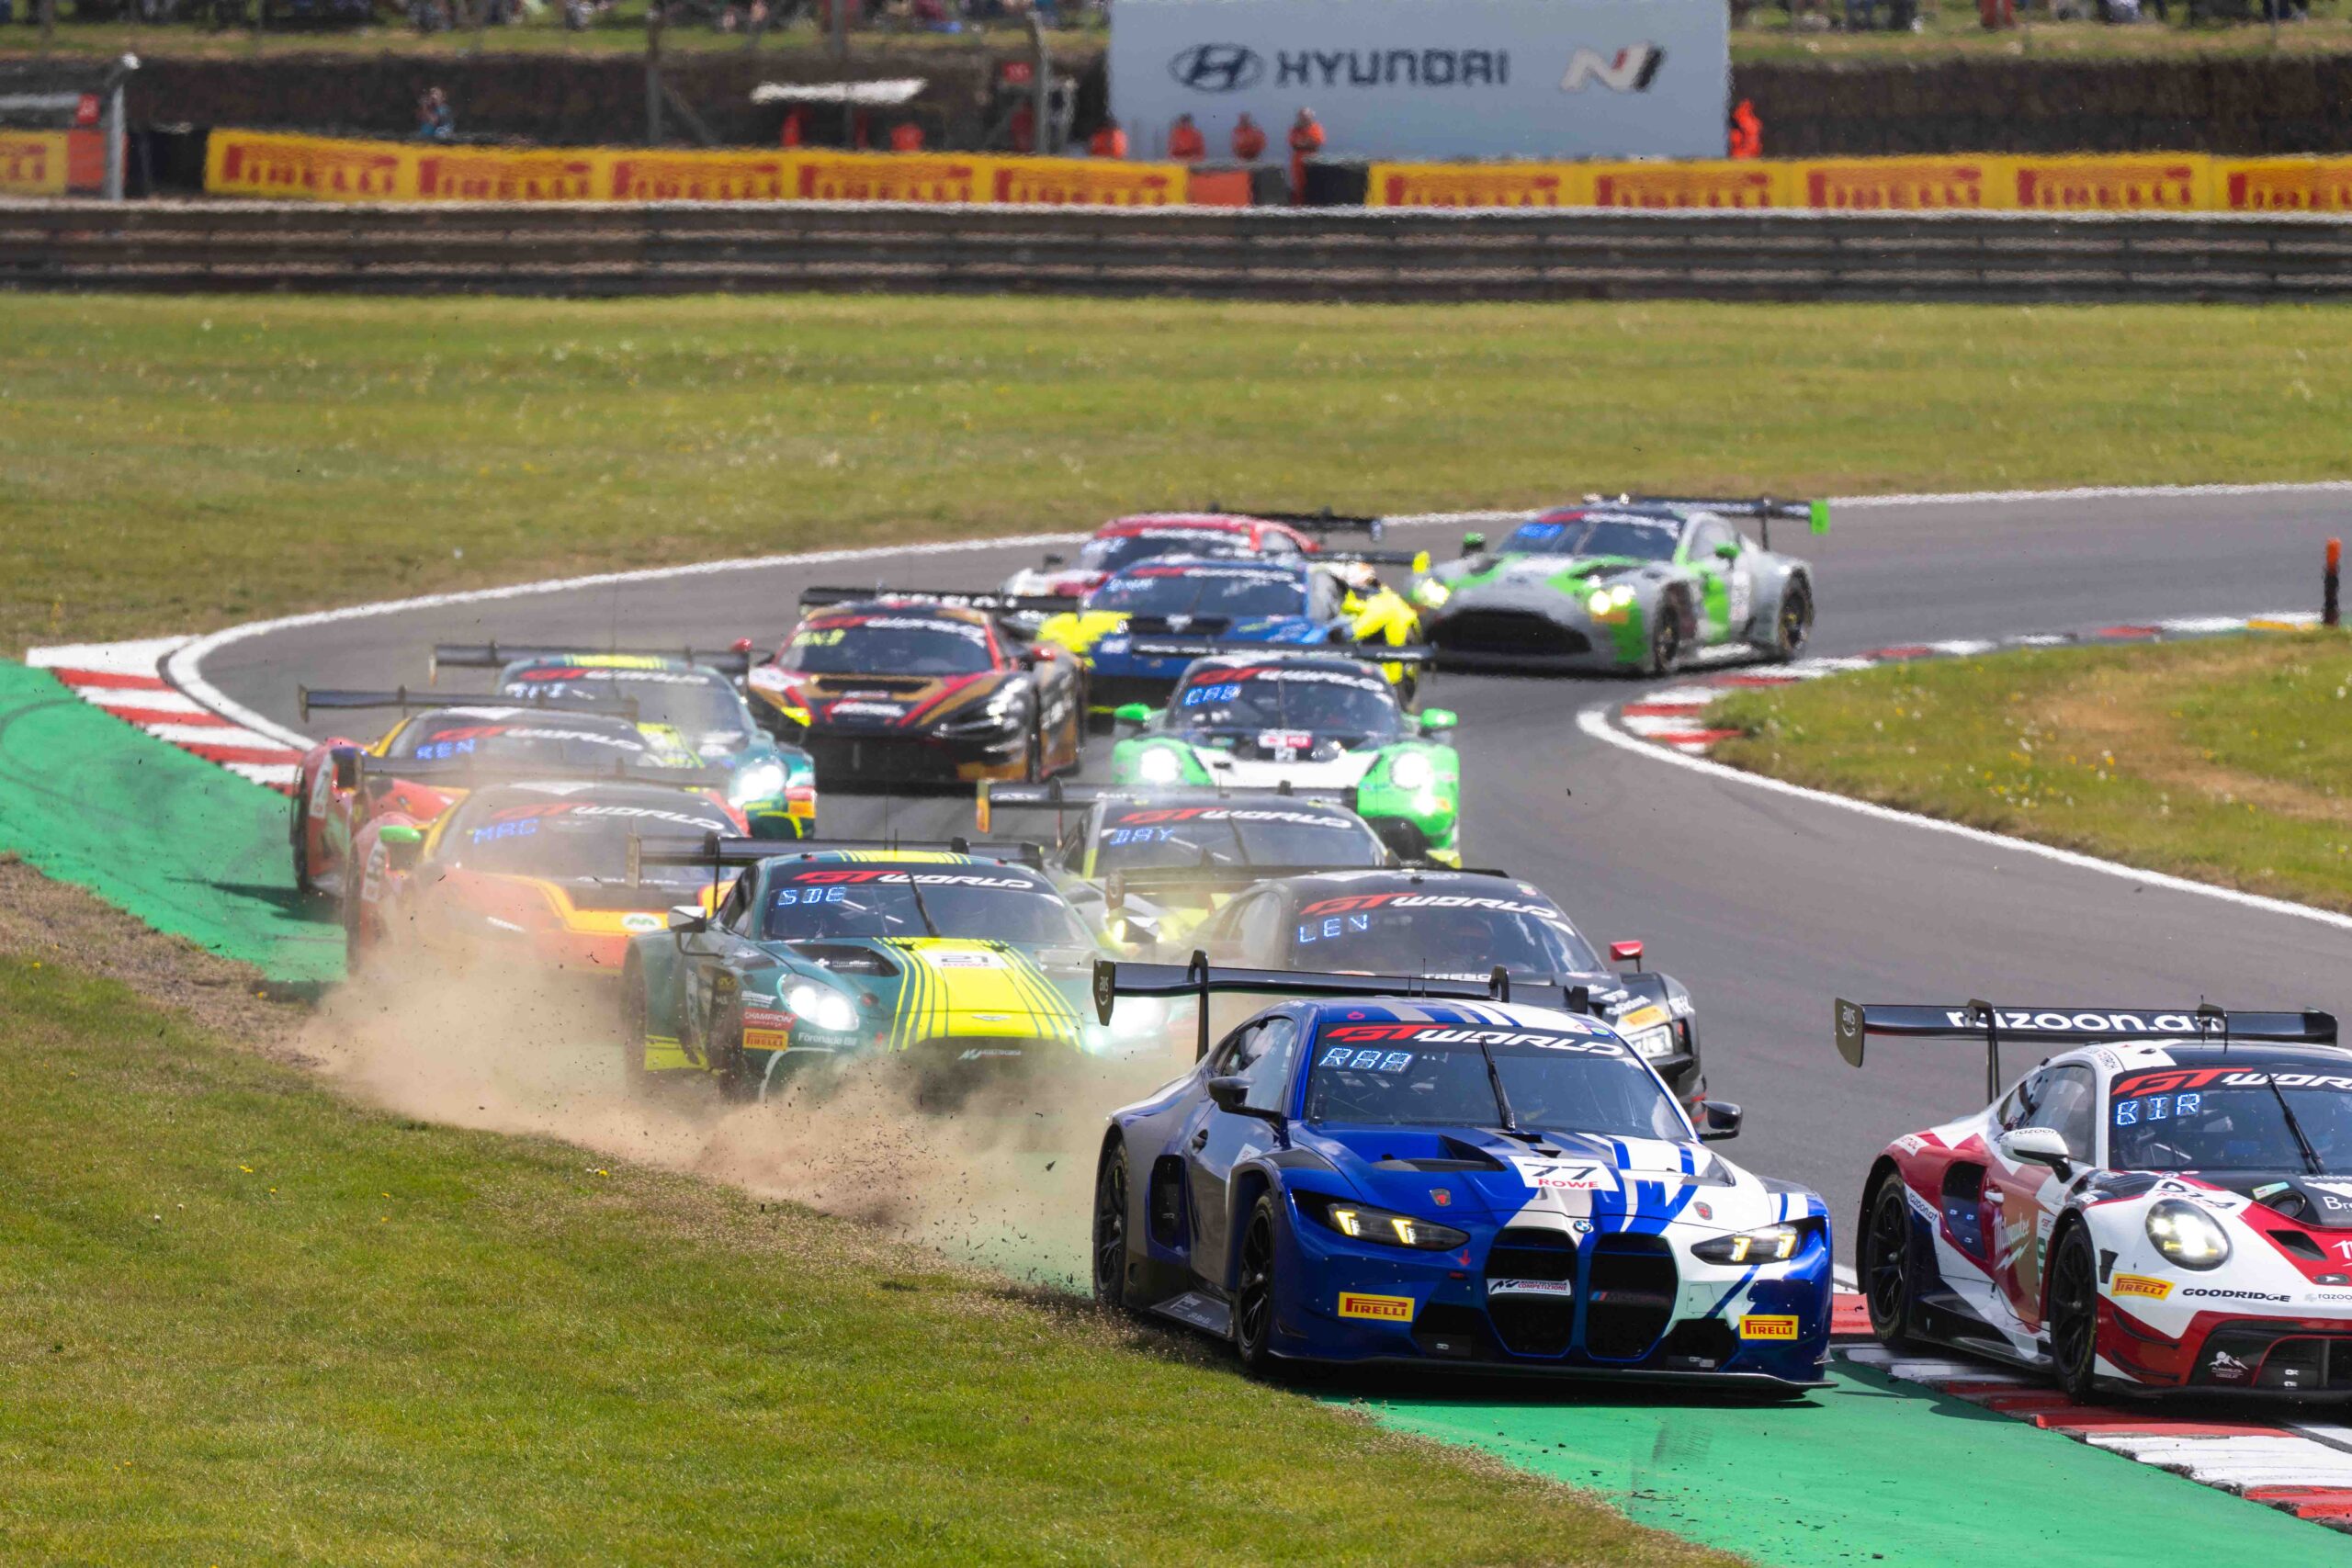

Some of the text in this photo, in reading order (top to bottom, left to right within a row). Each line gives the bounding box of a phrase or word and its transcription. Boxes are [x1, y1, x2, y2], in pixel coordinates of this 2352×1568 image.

[1276, 49, 1510, 88] HYUNDAI
[1109, 829, 1175, 845] DAY
[1421, 973, 1494, 983] TRESO
[1523, 1163, 1598, 1180] 77
[1538, 1178, 1600, 1189] ROWE
[2116, 1278, 2168, 1296] PIRELLI
[2182, 1288, 2291, 1303] GOODRIDGE
[1345, 1297, 1408, 1317] PIRELLI
[1745, 1319, 1794, 1336] PIRELLI
